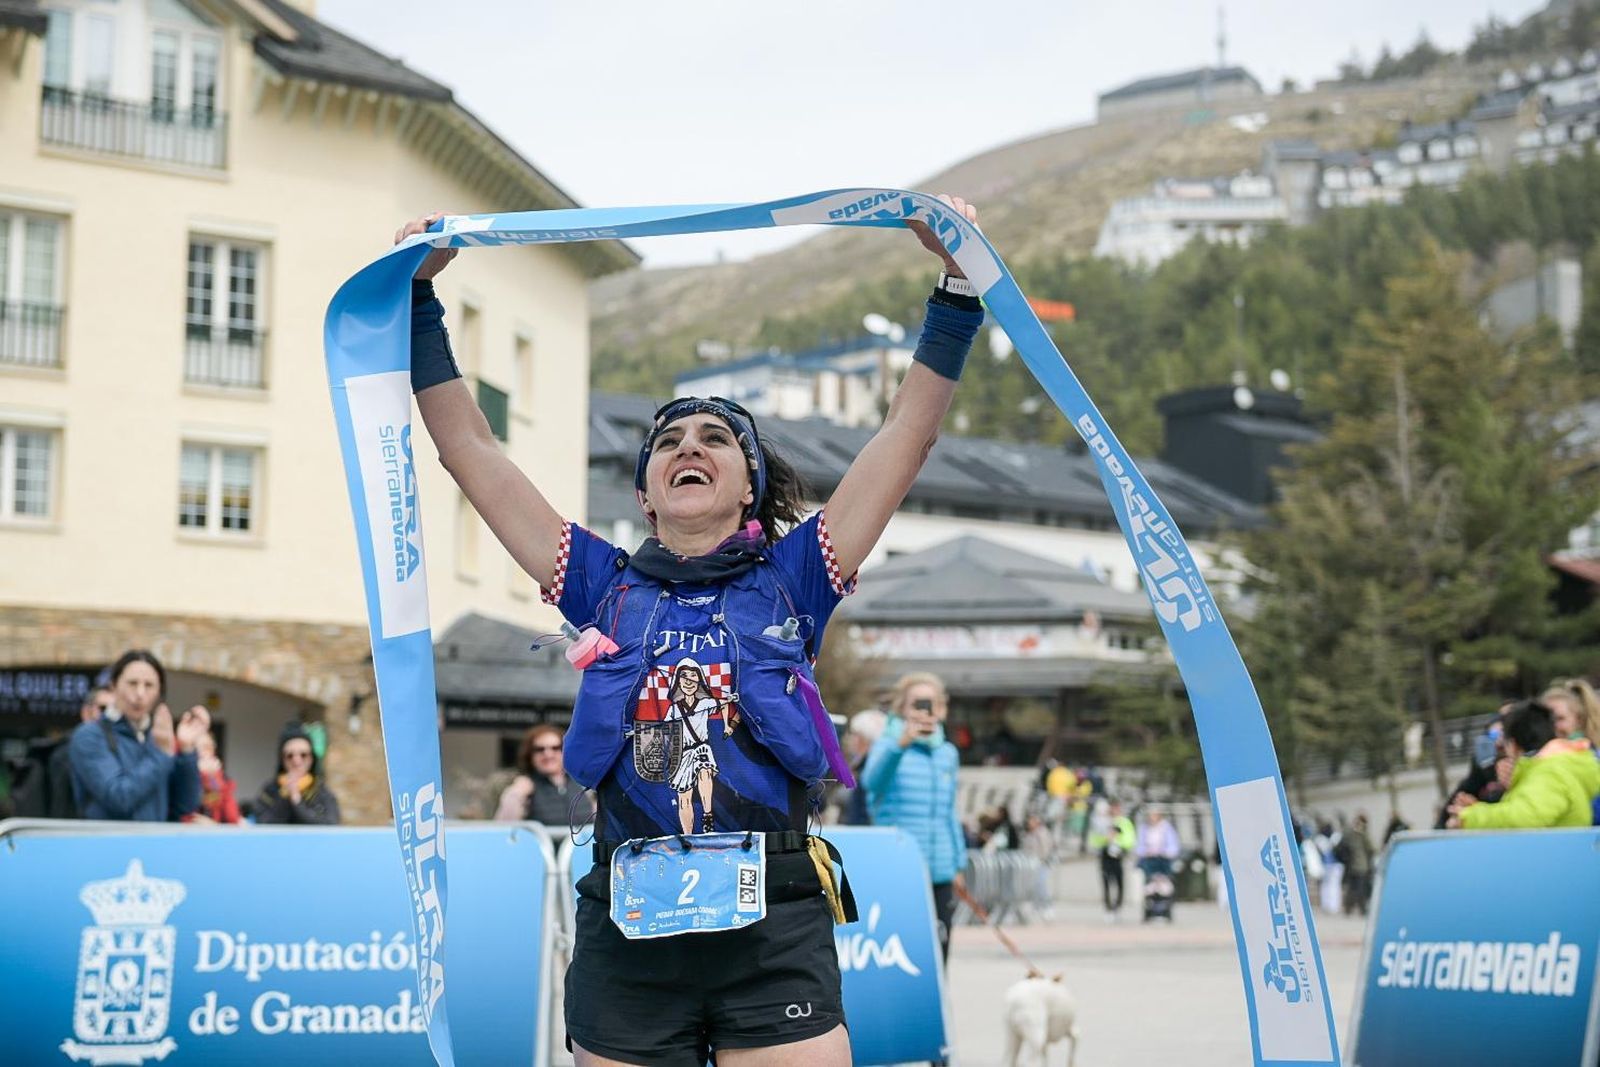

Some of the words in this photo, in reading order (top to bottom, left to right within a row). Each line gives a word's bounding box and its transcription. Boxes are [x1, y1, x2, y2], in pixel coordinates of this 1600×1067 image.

[379, 425, 405, 583] sierranevada
[677, 869, 701, 905] 2
[1261, 837, 1301, 1003] ULTRA
[1271, 834, 1314, 1003] sierranevada
[188, 990, 240, 1035] de
[251, 989, 428, 1035] Granada
[1377, 926, 1581, 996] sierranevada
